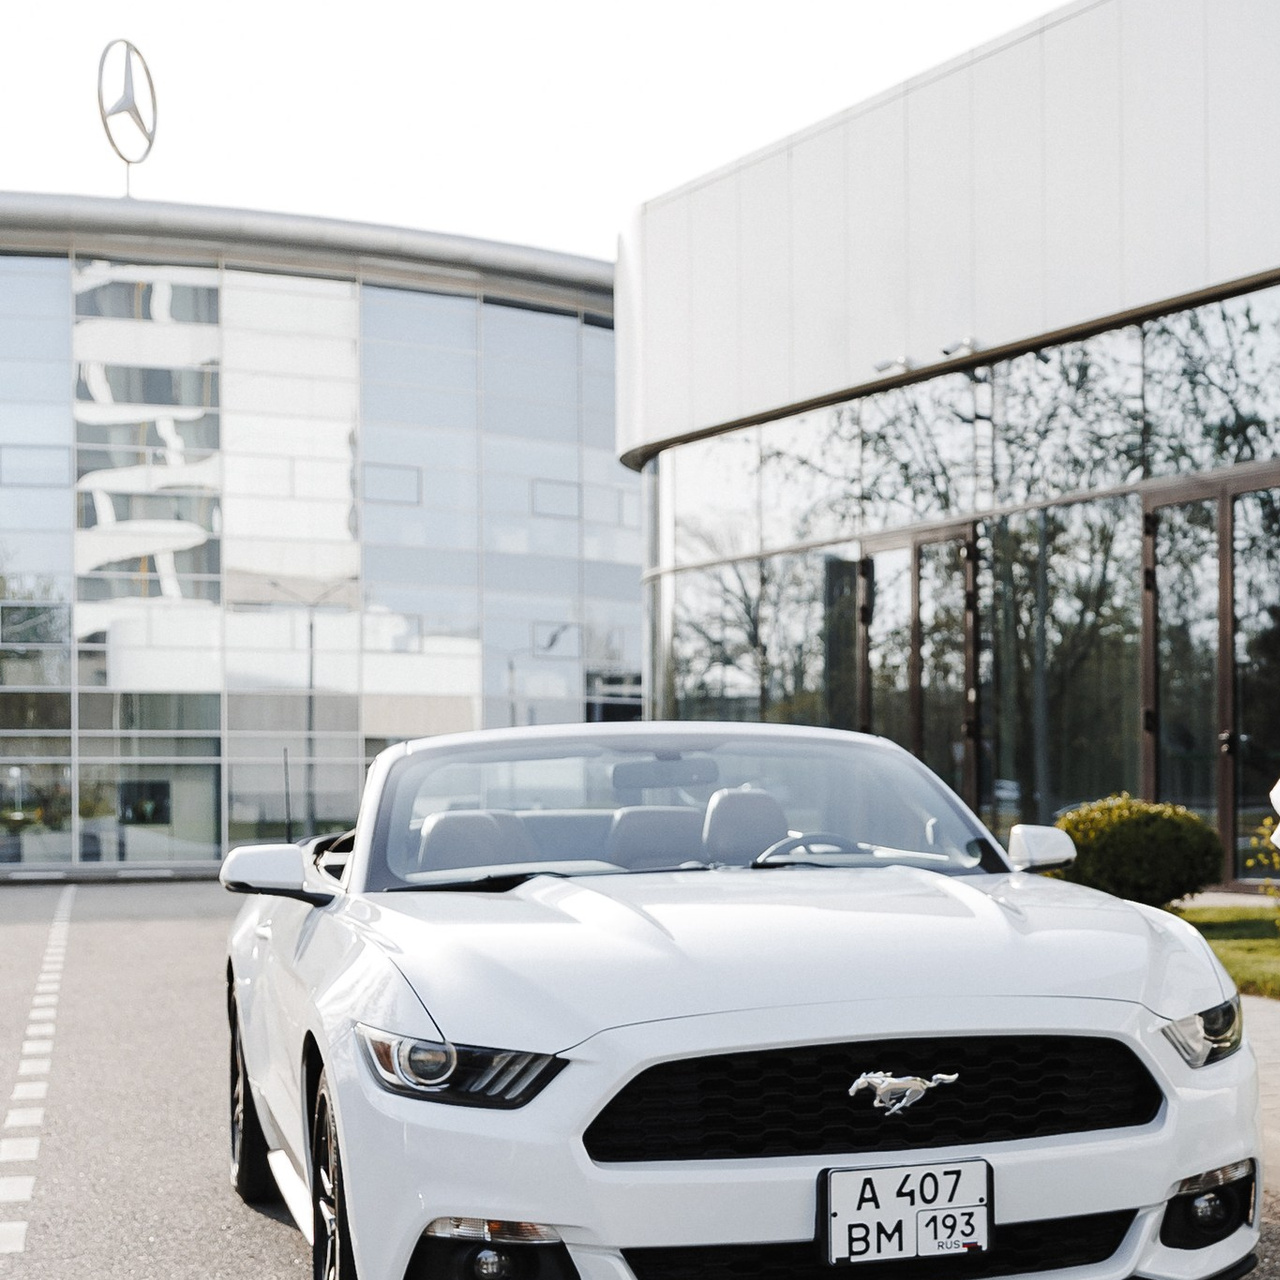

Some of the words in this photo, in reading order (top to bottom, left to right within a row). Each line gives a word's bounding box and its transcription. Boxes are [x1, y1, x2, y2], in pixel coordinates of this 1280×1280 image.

[856, 1177, 880, 1211] A
[896, 1170, 962, 1206] 407
[848, 1219, 903, 1256] BM
[924, 1211, 976, 1240] 193
[937, 1241, 961, 1250] RUS
